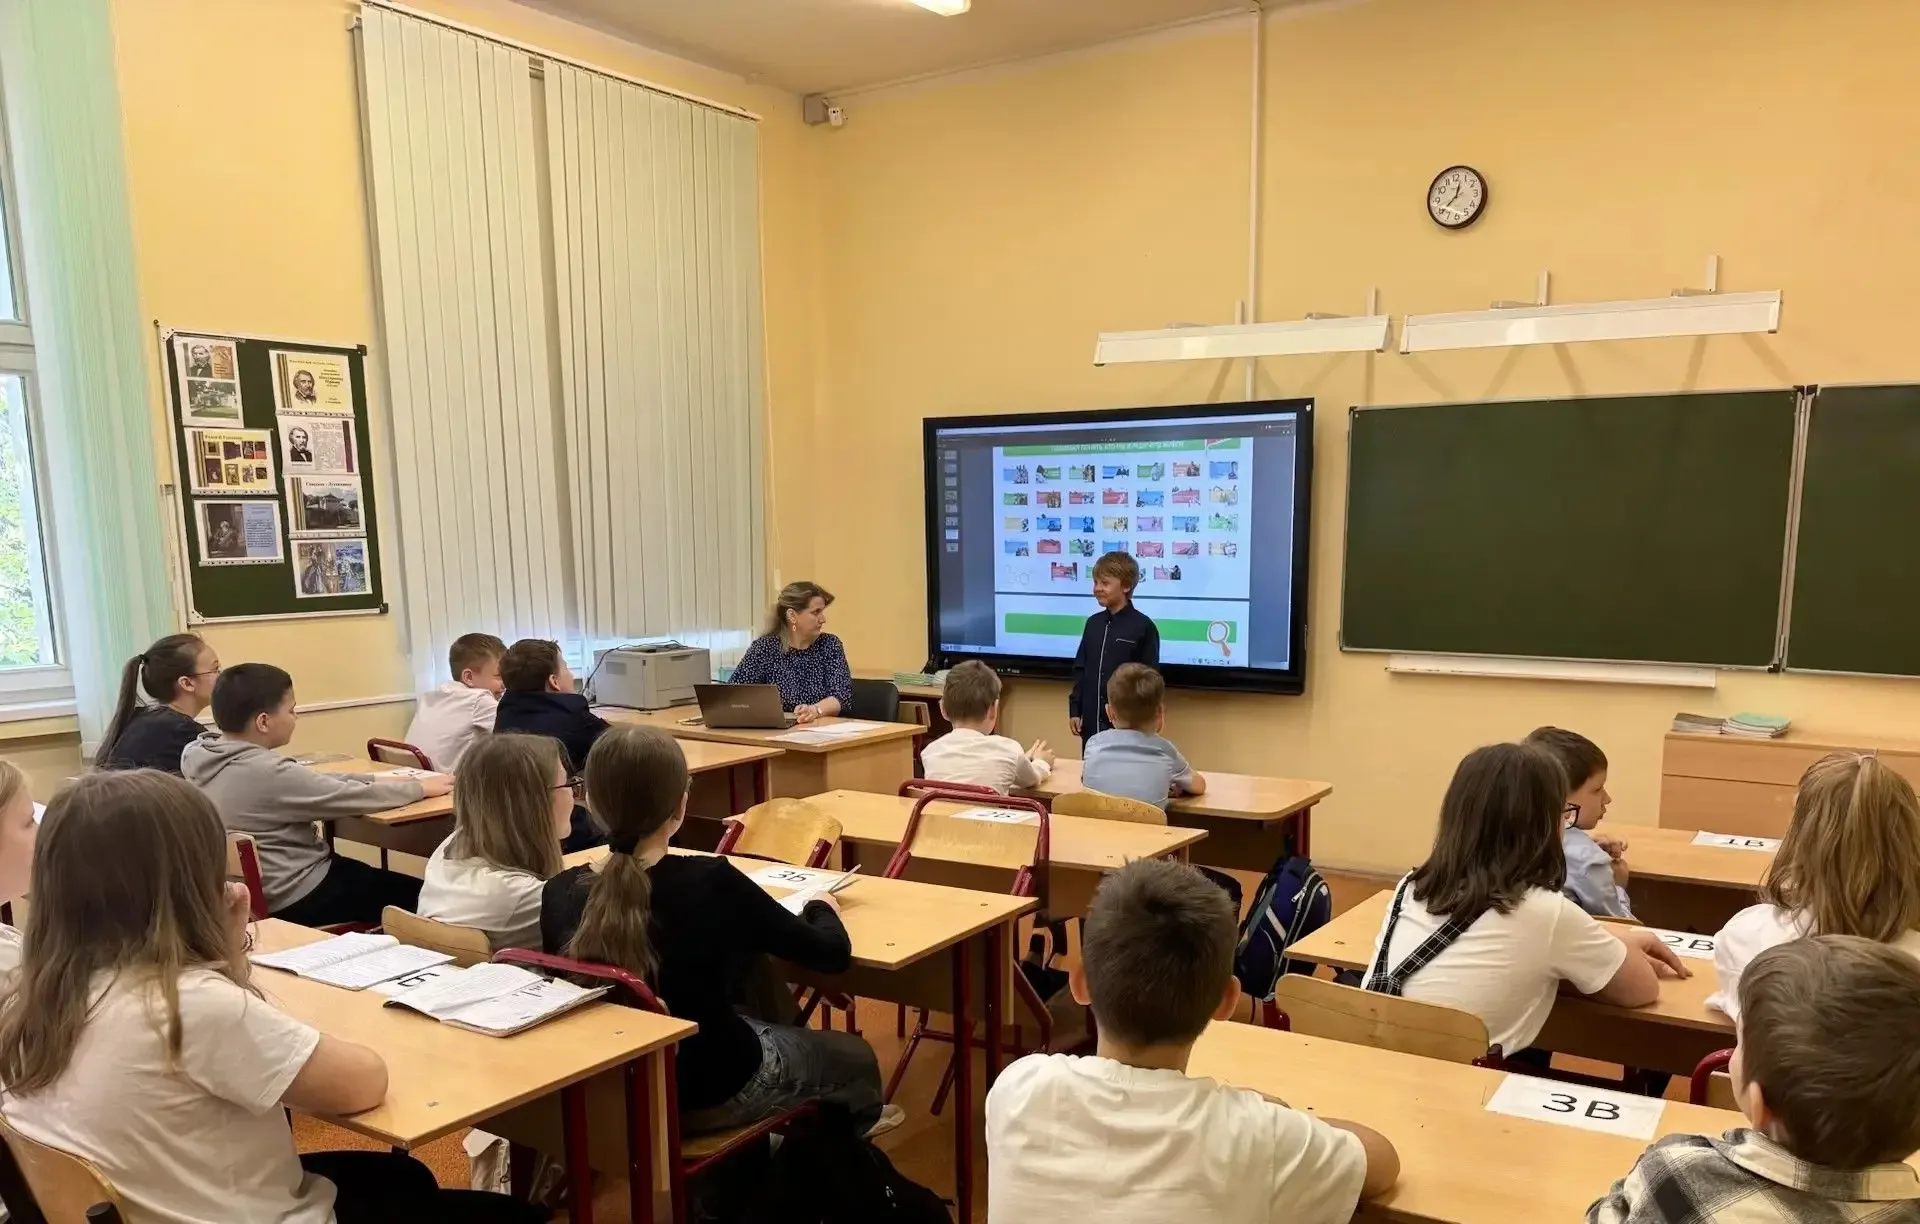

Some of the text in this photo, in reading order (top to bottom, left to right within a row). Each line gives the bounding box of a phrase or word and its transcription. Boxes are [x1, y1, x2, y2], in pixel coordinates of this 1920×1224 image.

[1452, 174, 1460, 182] 12
[1469, 180, 1476, 188] 2
[1438, 185, 1447, 195] 10
[1473, 189, 1478, 198] 3
[1469, 200, 1476, 208] 4
[1463, 208, 1469, 216] 5
[1454, 213, 1460, 221] 6
[767, 870, 816, 883] 3Б
[1541, 1093, 1622, 1121] 3В
